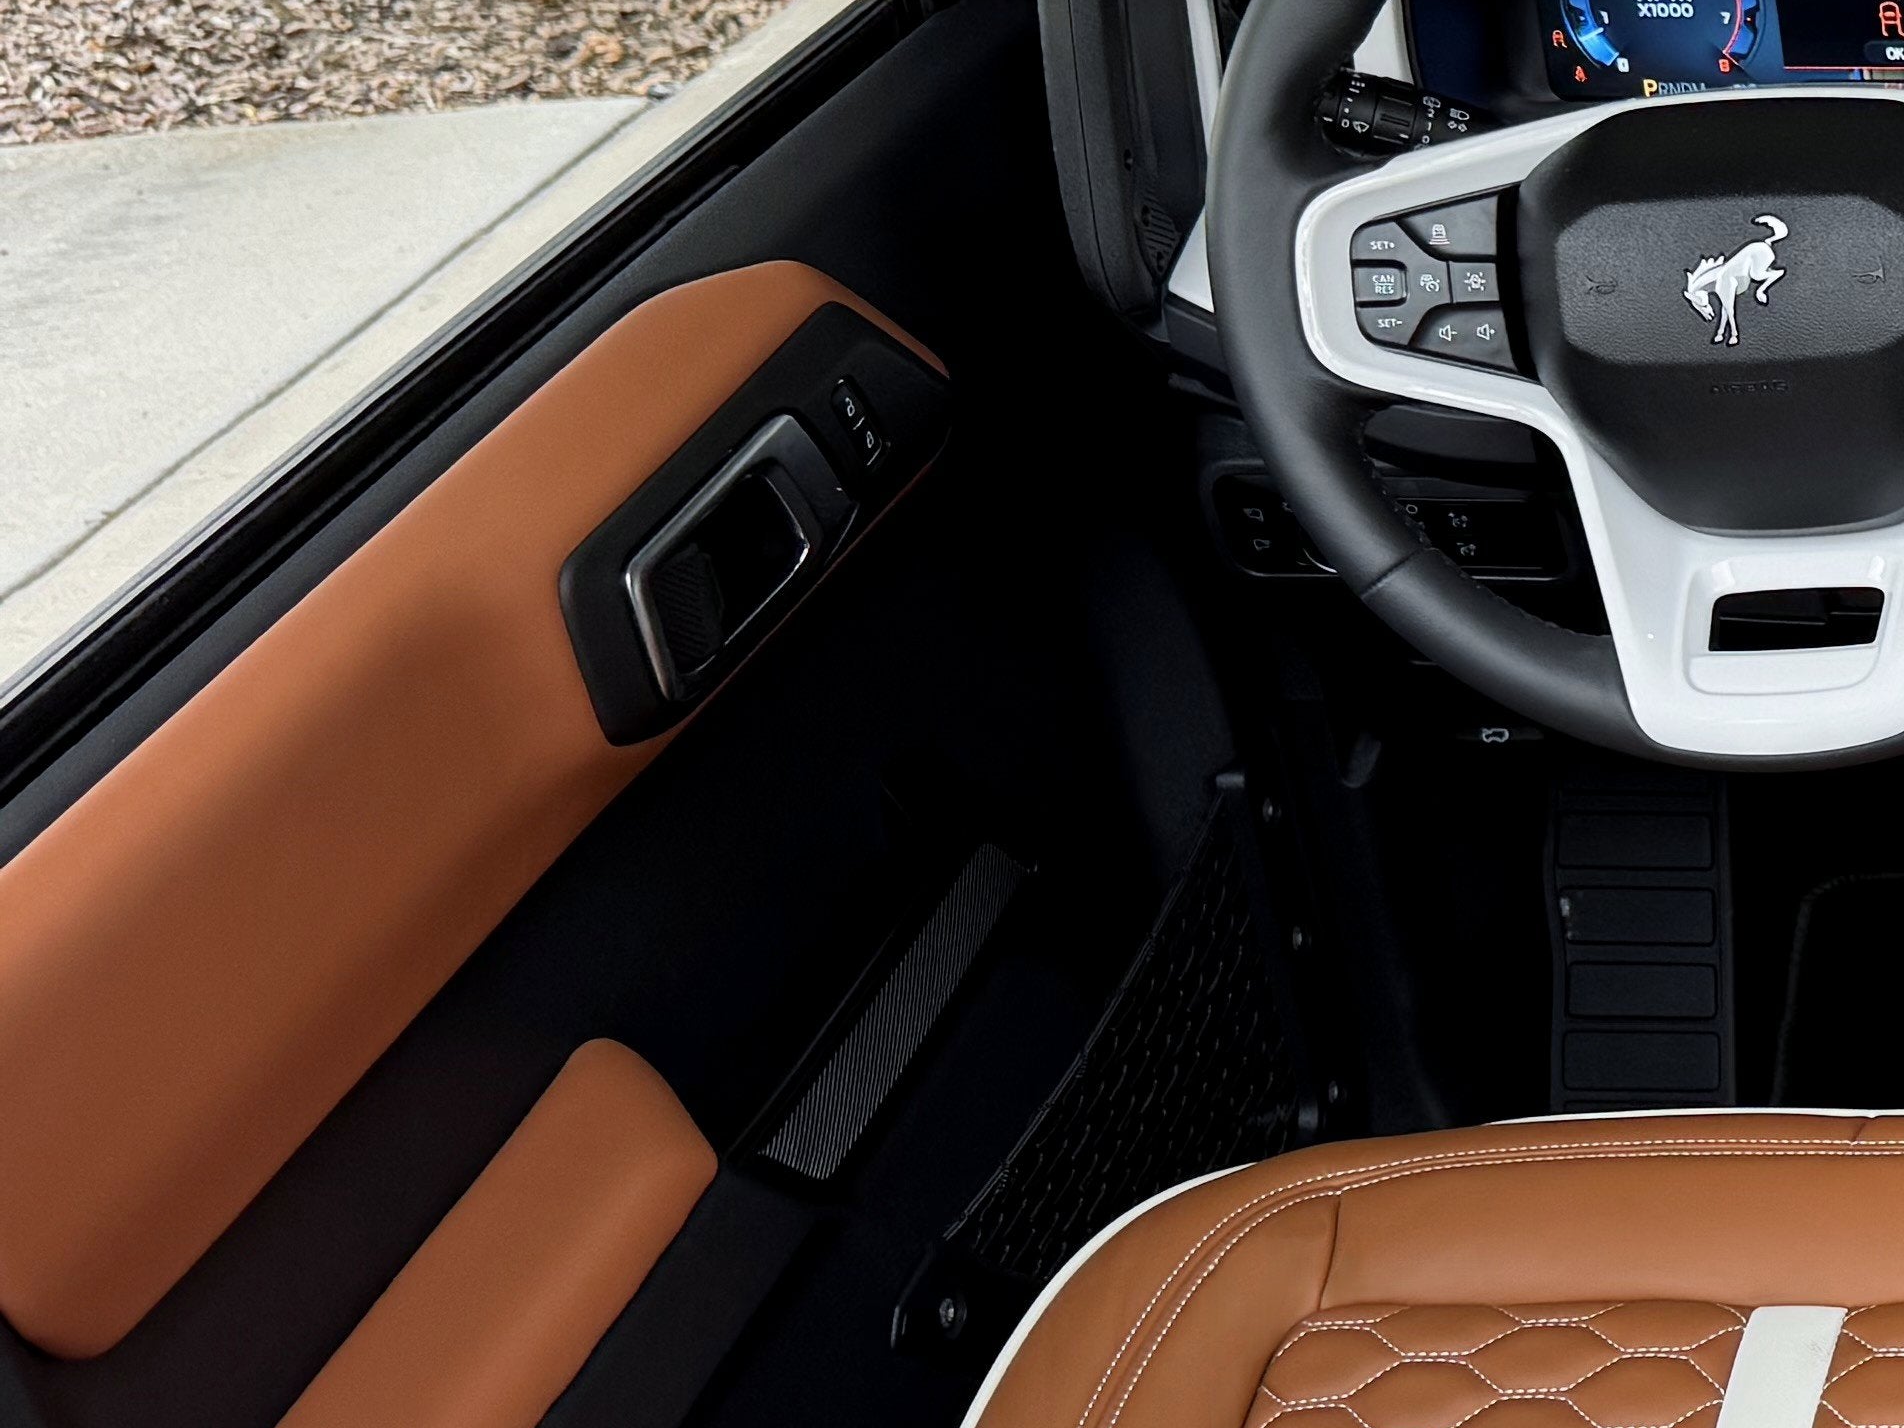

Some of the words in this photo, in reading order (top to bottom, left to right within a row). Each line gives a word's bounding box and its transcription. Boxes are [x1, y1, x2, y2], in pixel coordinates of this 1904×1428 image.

[1638, 3, 1693, 17] X1000
[1601, 11, 1609, 24] 1
[1720, 11, 1730, 24] 7
[1617, 57, 1629, 72] 0
[1719, 60, 1729, 72] 8
[1372, 275, 1394, 284] CAN
